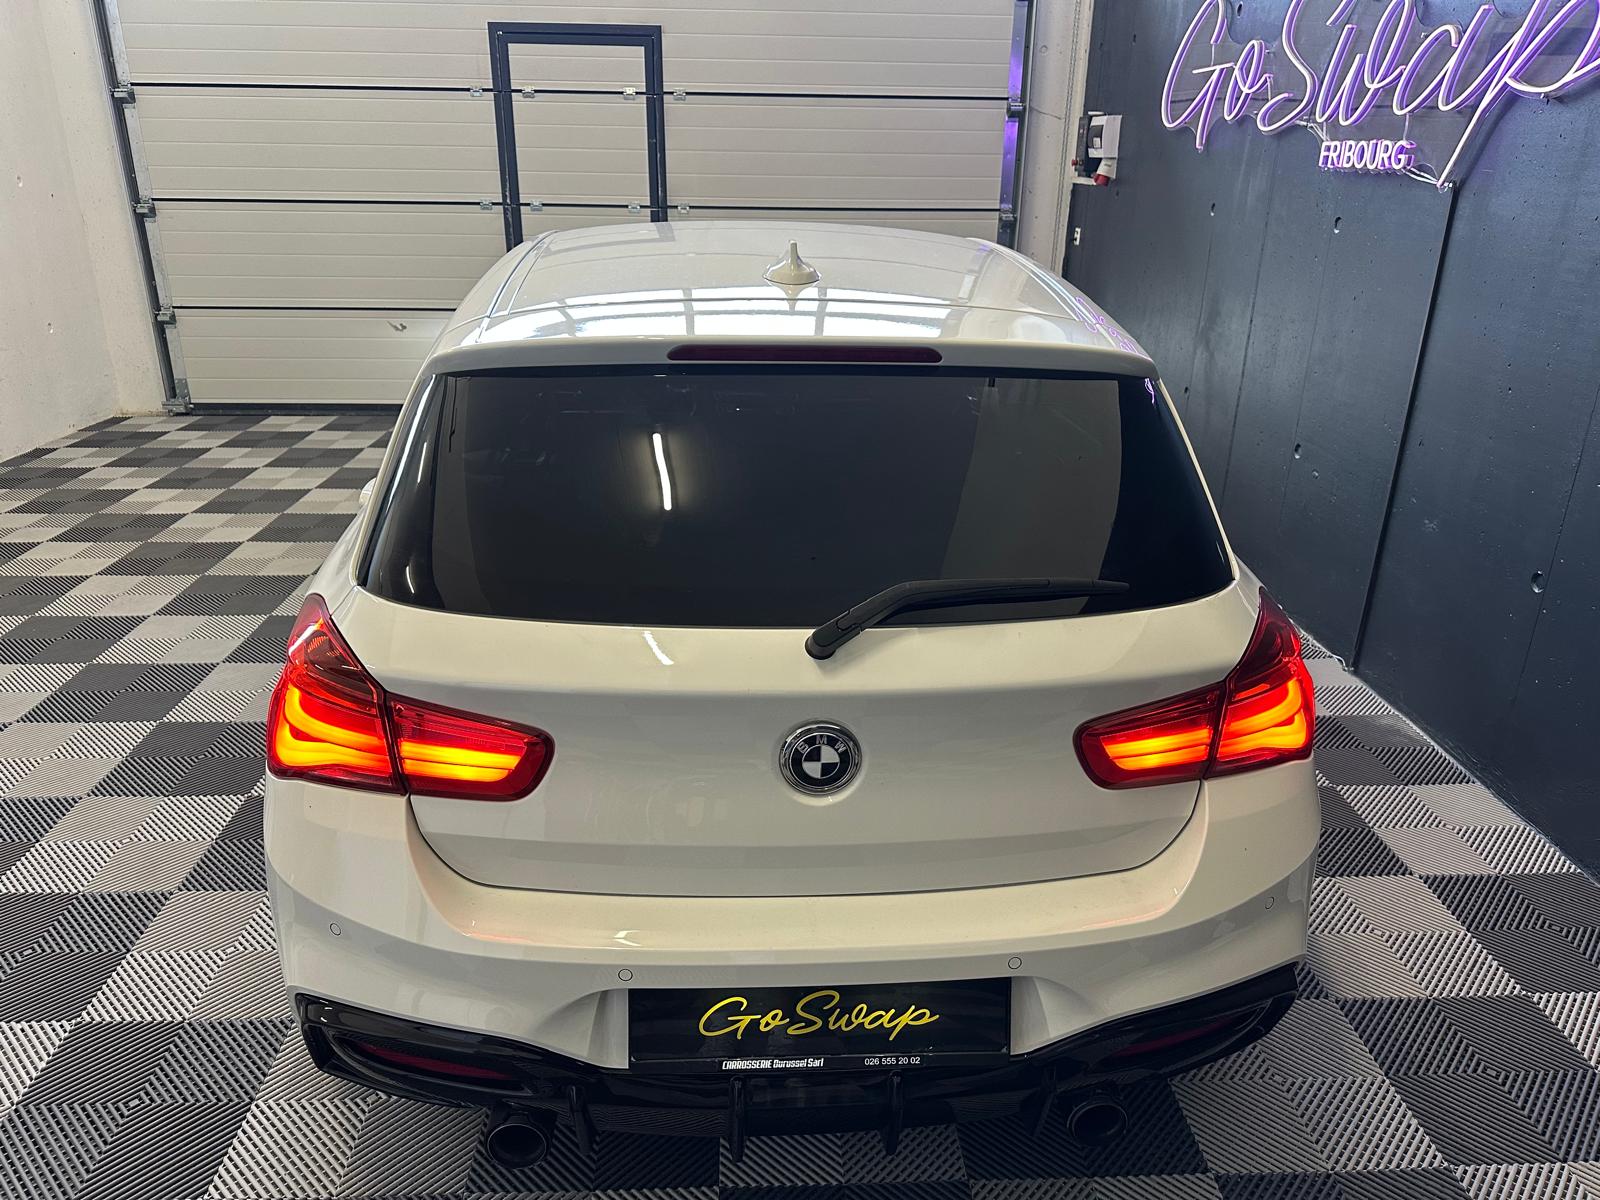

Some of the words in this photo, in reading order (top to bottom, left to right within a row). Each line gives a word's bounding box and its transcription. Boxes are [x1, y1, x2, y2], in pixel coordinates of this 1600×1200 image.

[1318, 139, 1416, 169] FRIBOURG
[797, 735, 847, 754] BMW
[722, 1060, 772, 1070] CARROSSERIE
[772, 1059, 807, 1069] Durussel
[864, 1057, 880, 1066] 026
[881, 1057, 897, 1065] 555
[898, 1056, 909, 1065] 20
[910, 1056, 921, 1064] 02
